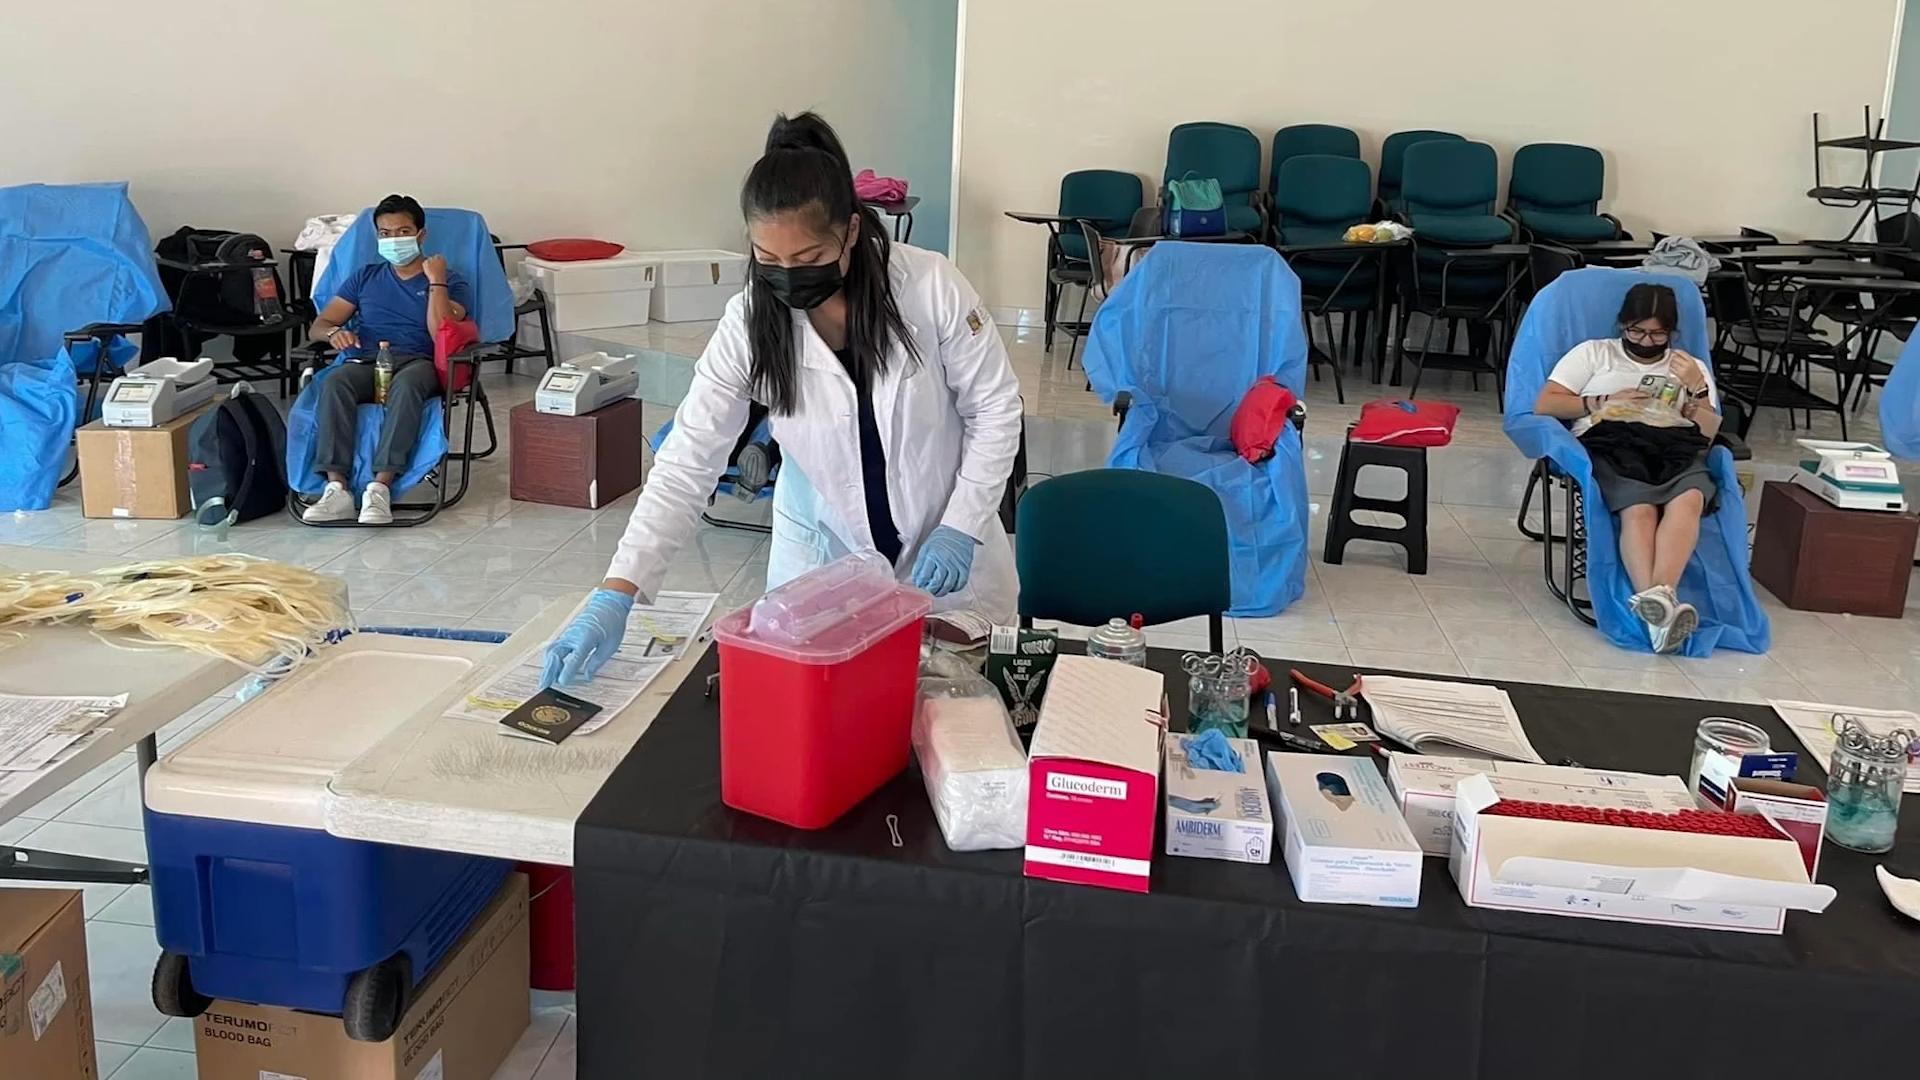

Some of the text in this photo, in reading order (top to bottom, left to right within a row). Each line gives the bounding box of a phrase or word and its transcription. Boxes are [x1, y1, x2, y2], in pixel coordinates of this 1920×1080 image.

[1051, 775, 1122, 796] Glucoderm
[1175, 819, 1221, 836] AMBIDERM
[204, 1027, 272, 1047] BLOOD BAG
